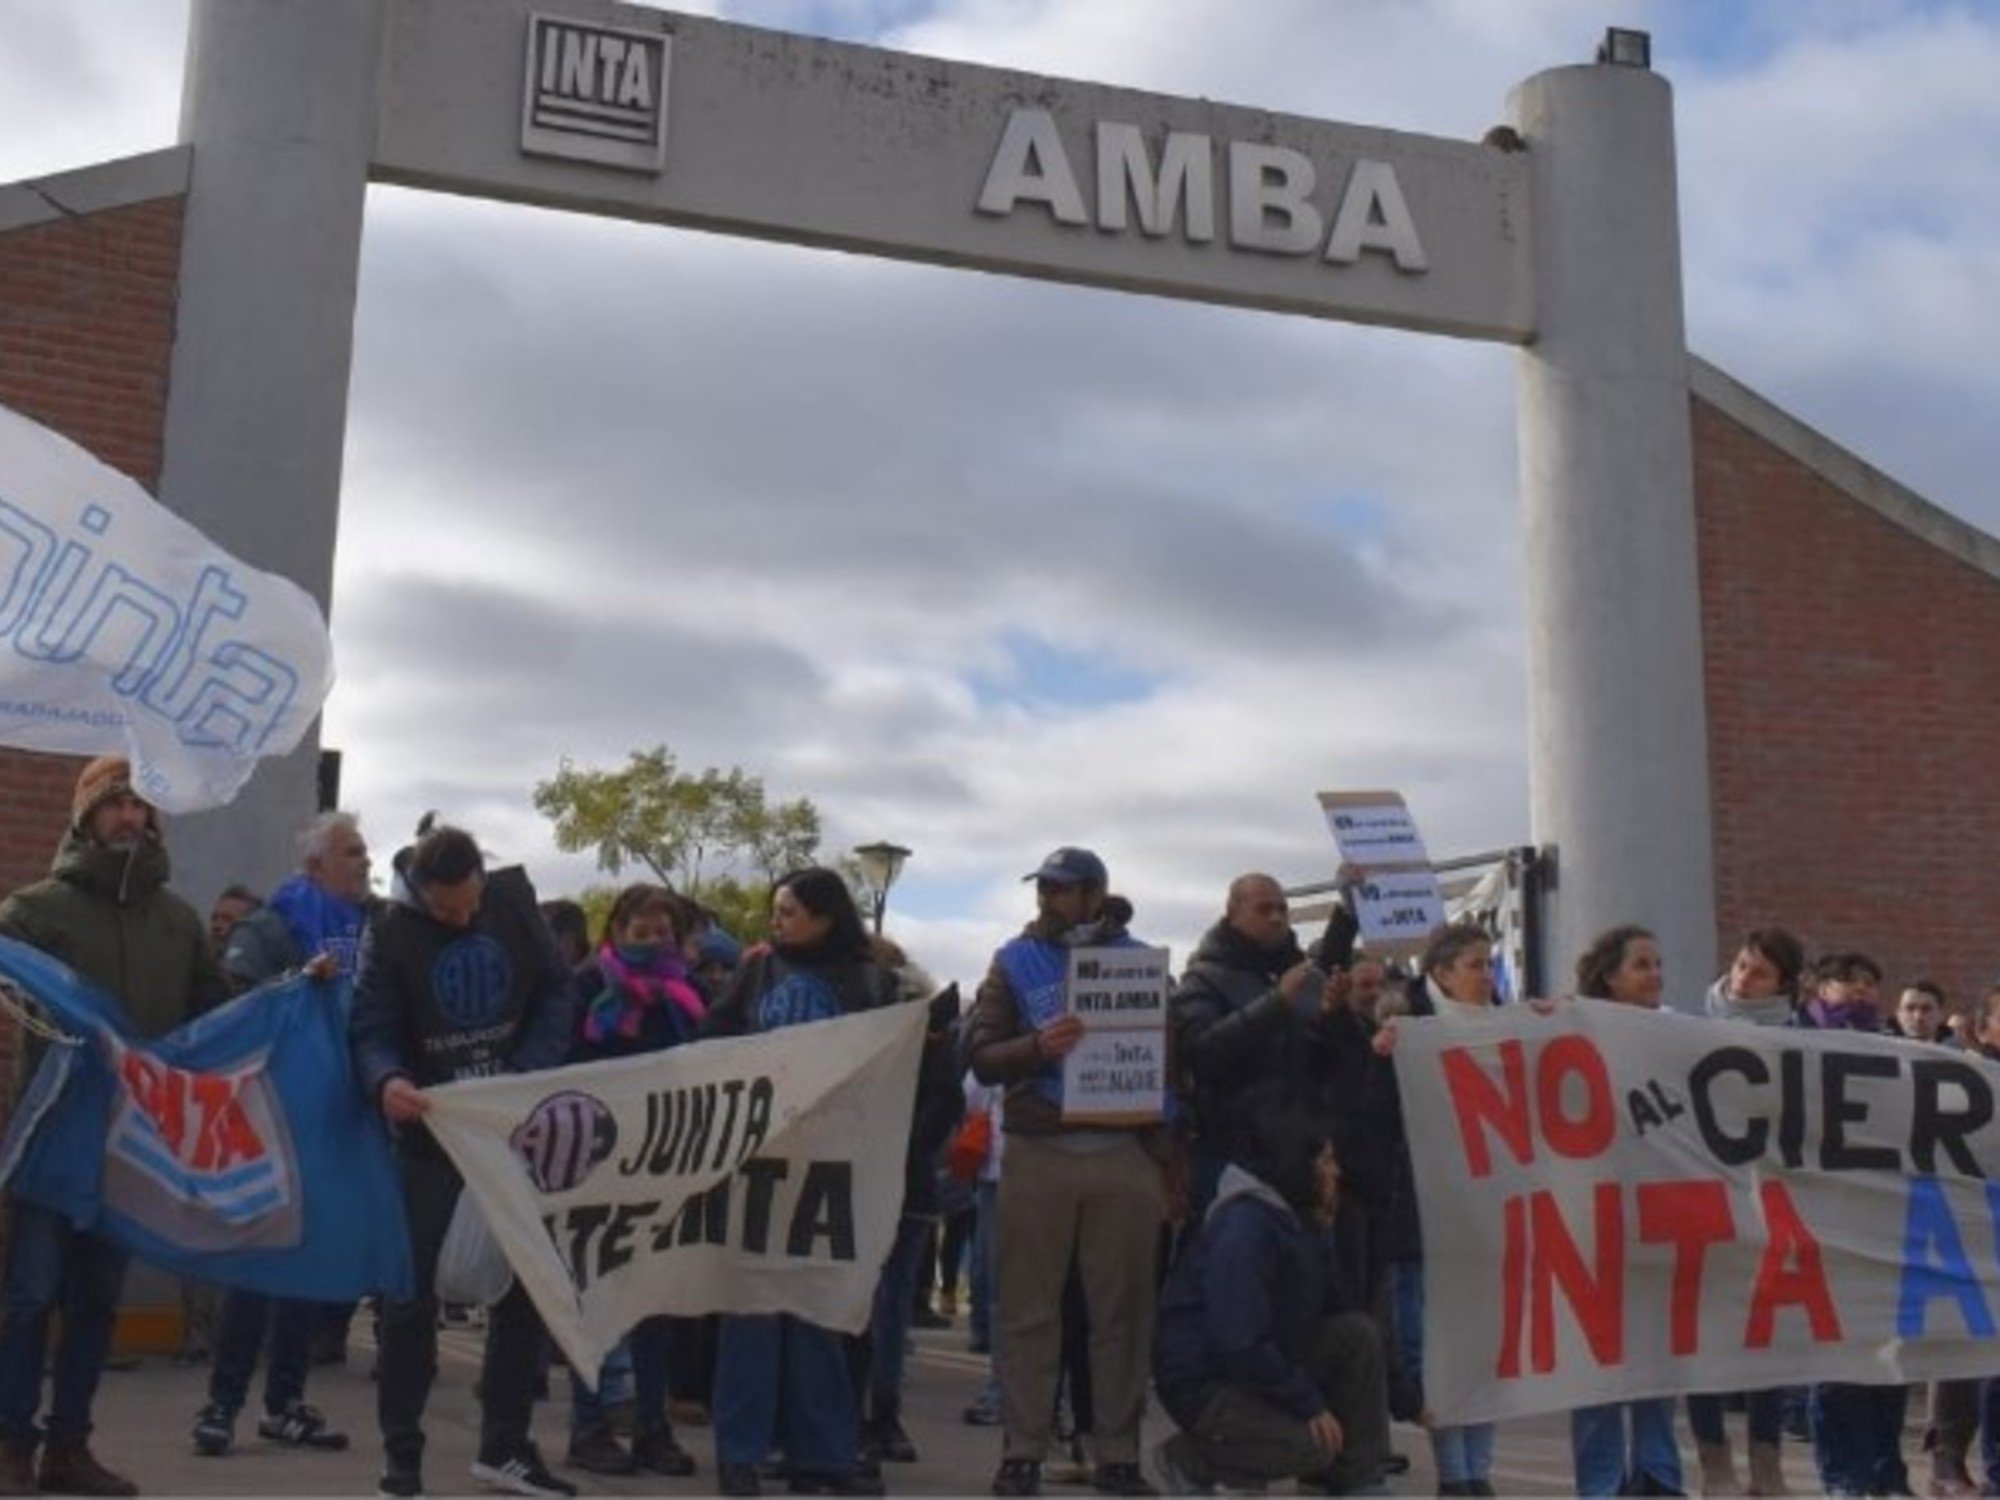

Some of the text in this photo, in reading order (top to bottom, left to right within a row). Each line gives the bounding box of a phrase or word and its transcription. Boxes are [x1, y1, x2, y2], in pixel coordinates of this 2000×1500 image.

[542, 26, 652, 108] INTA
[975, 106, 1428, 273] AMBA
[618, 1075, 774, 1176] JUNTA
[1440, 1034, 1995, 1179] NO AL CIER
[1495, 1175, 2000, 1379] INTA A
